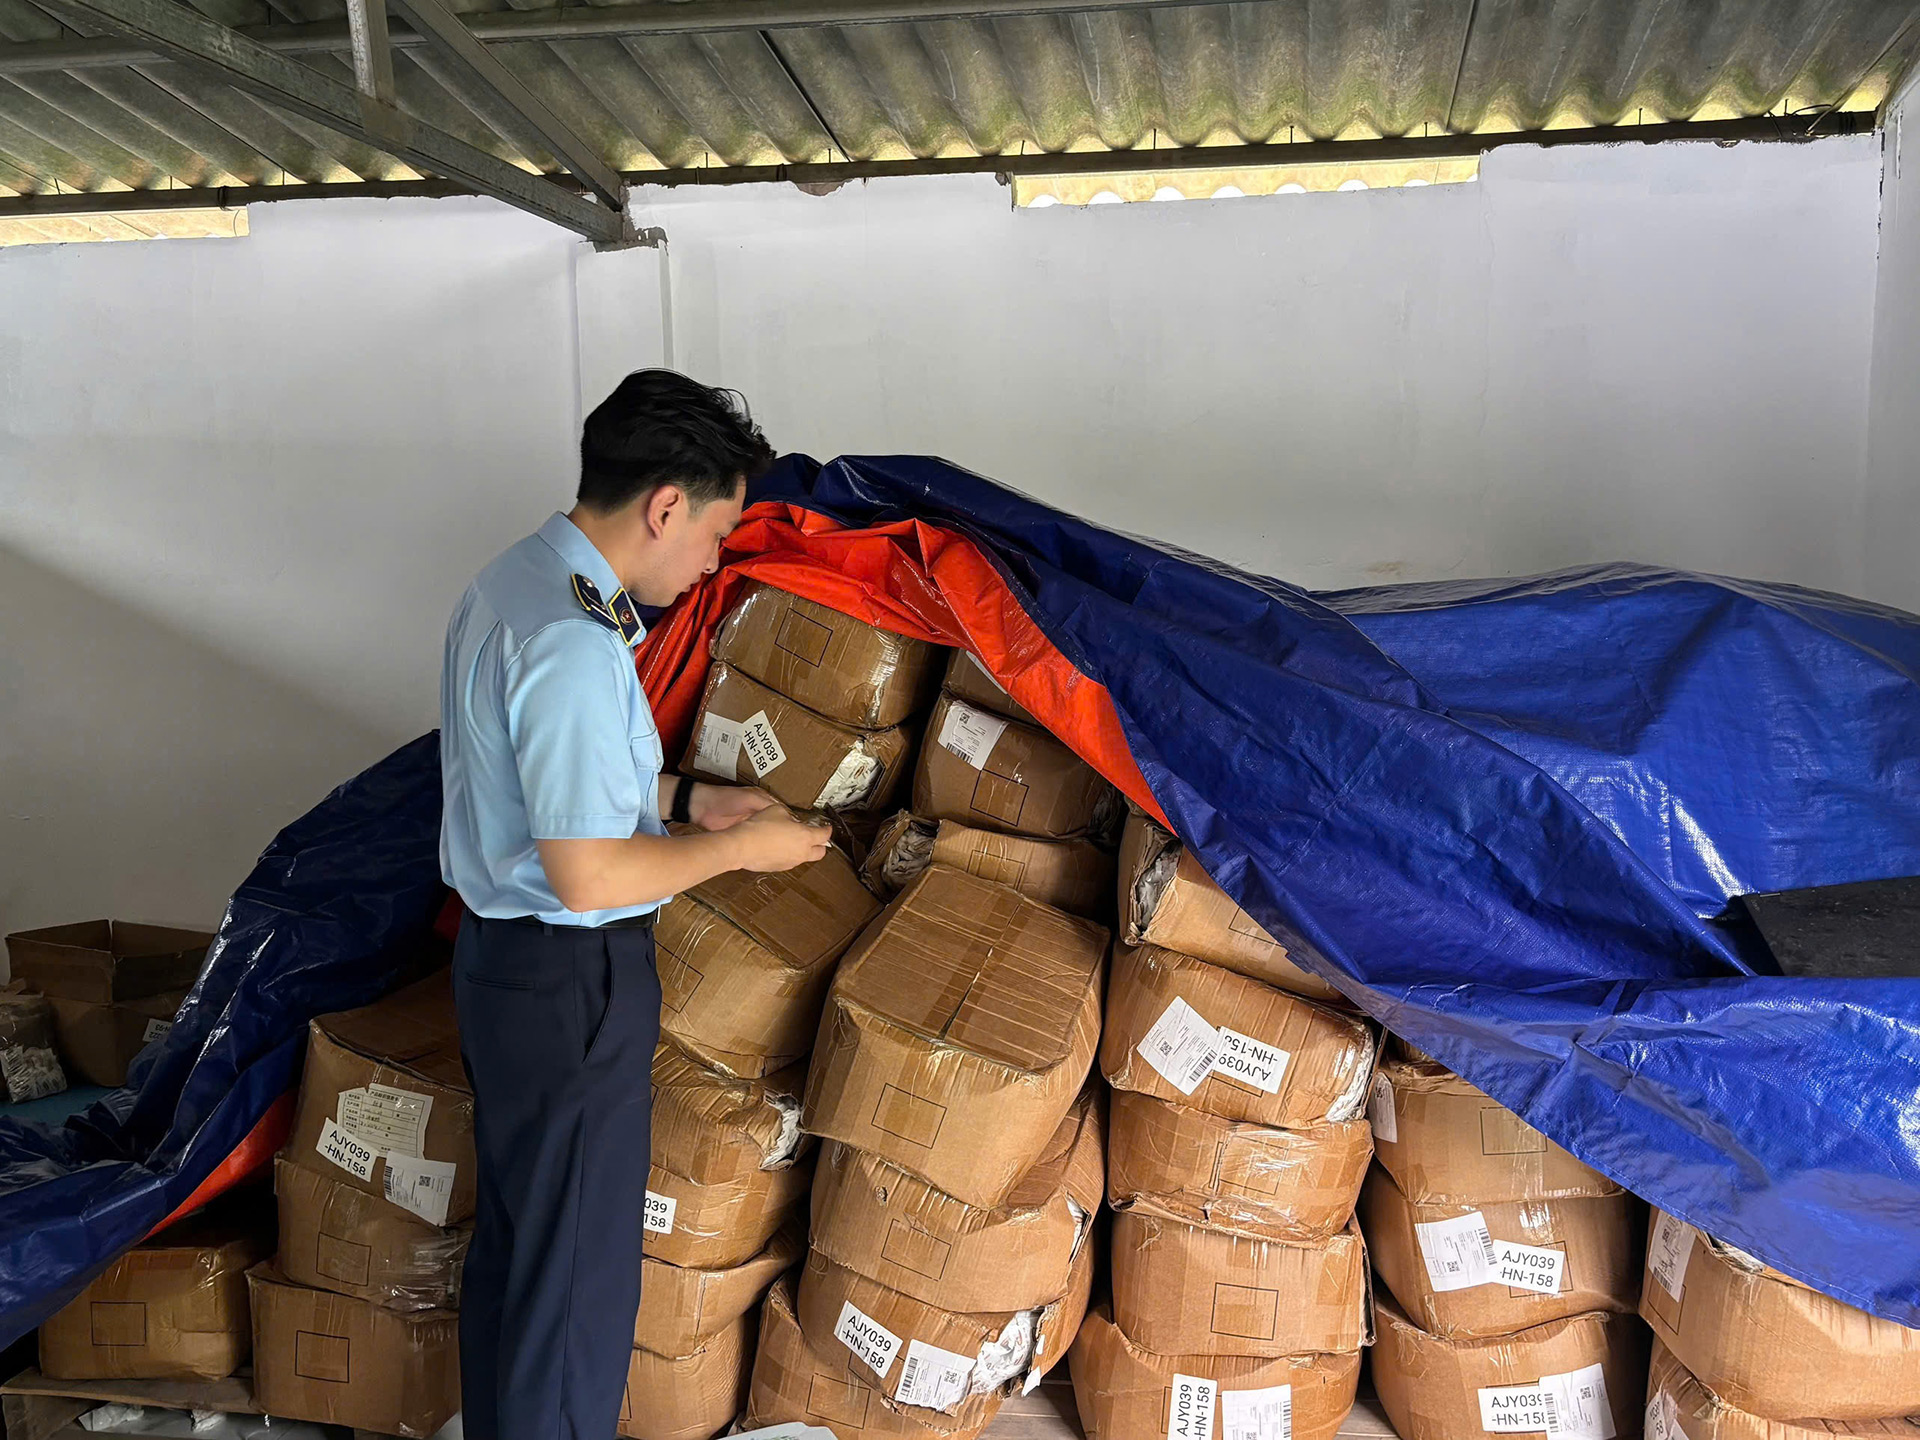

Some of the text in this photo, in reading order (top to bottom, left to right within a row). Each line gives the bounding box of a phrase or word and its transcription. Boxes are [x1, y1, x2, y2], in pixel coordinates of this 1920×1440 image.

[744, 730, 767, 770] -HN-158
[754, 723, 778, 761] AJY039
[1218, 1053, 1271, 1081] AJY039
[325, 1144, 366, 1175] -HN-158
[329, 1130, 370, 1162] AJY039
[1501, 1250, 1555, 1269] AJY039
[843, 1330, 885, 1368] -HN-158
[848, 1315, 891, 1352] AJY039
[1177, 1384, 1192, 1437] AJY039
